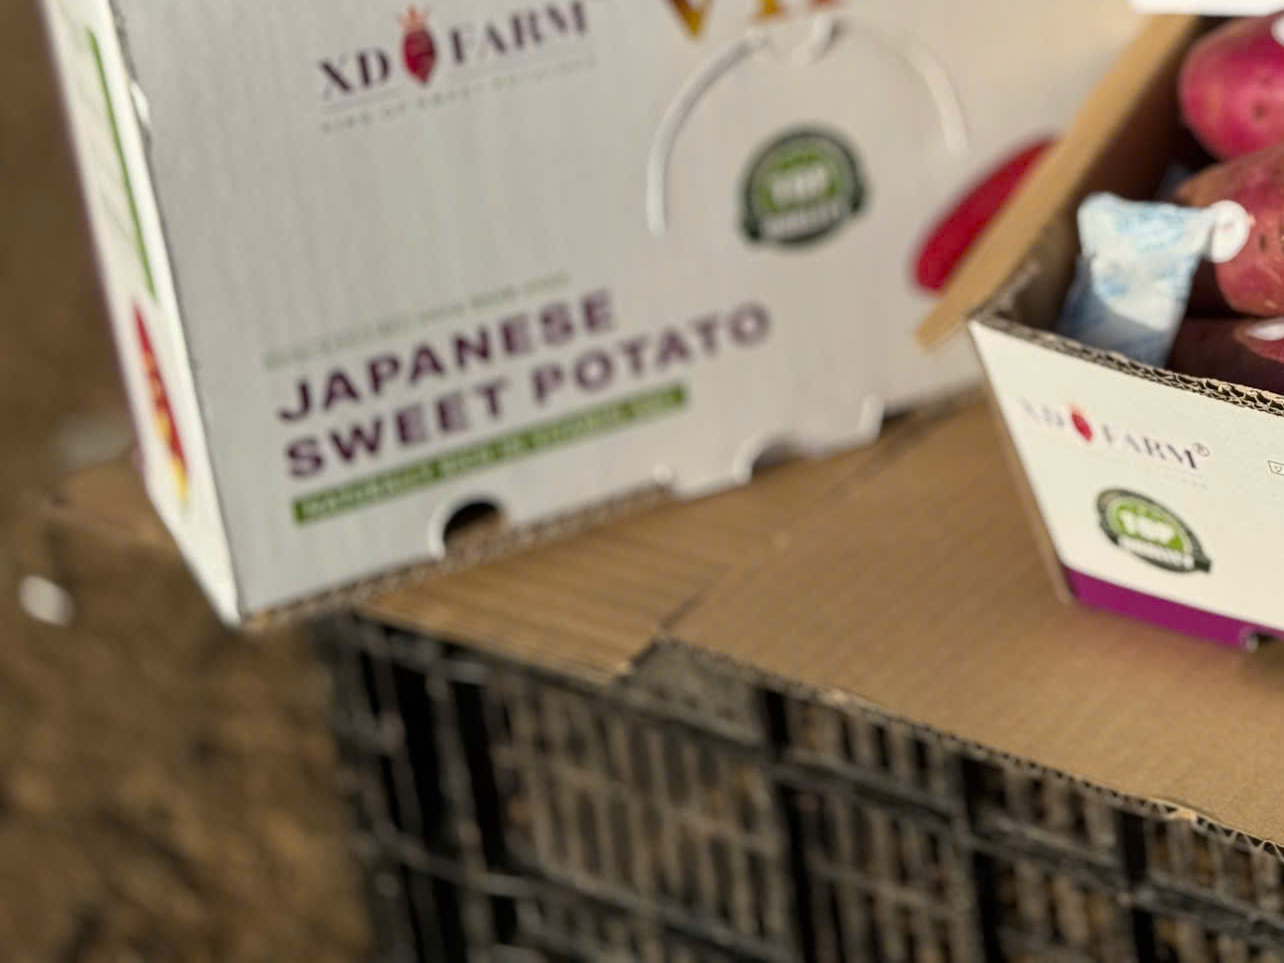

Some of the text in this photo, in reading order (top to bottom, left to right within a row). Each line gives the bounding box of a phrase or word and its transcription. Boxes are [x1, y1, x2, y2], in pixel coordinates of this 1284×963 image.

[319, 49, 391, 103] XD
[277, 287, 617, 425] JAPANESE
[285, 379, 511, 480] SWEET
[531, 300, 773, 408] POTATO
